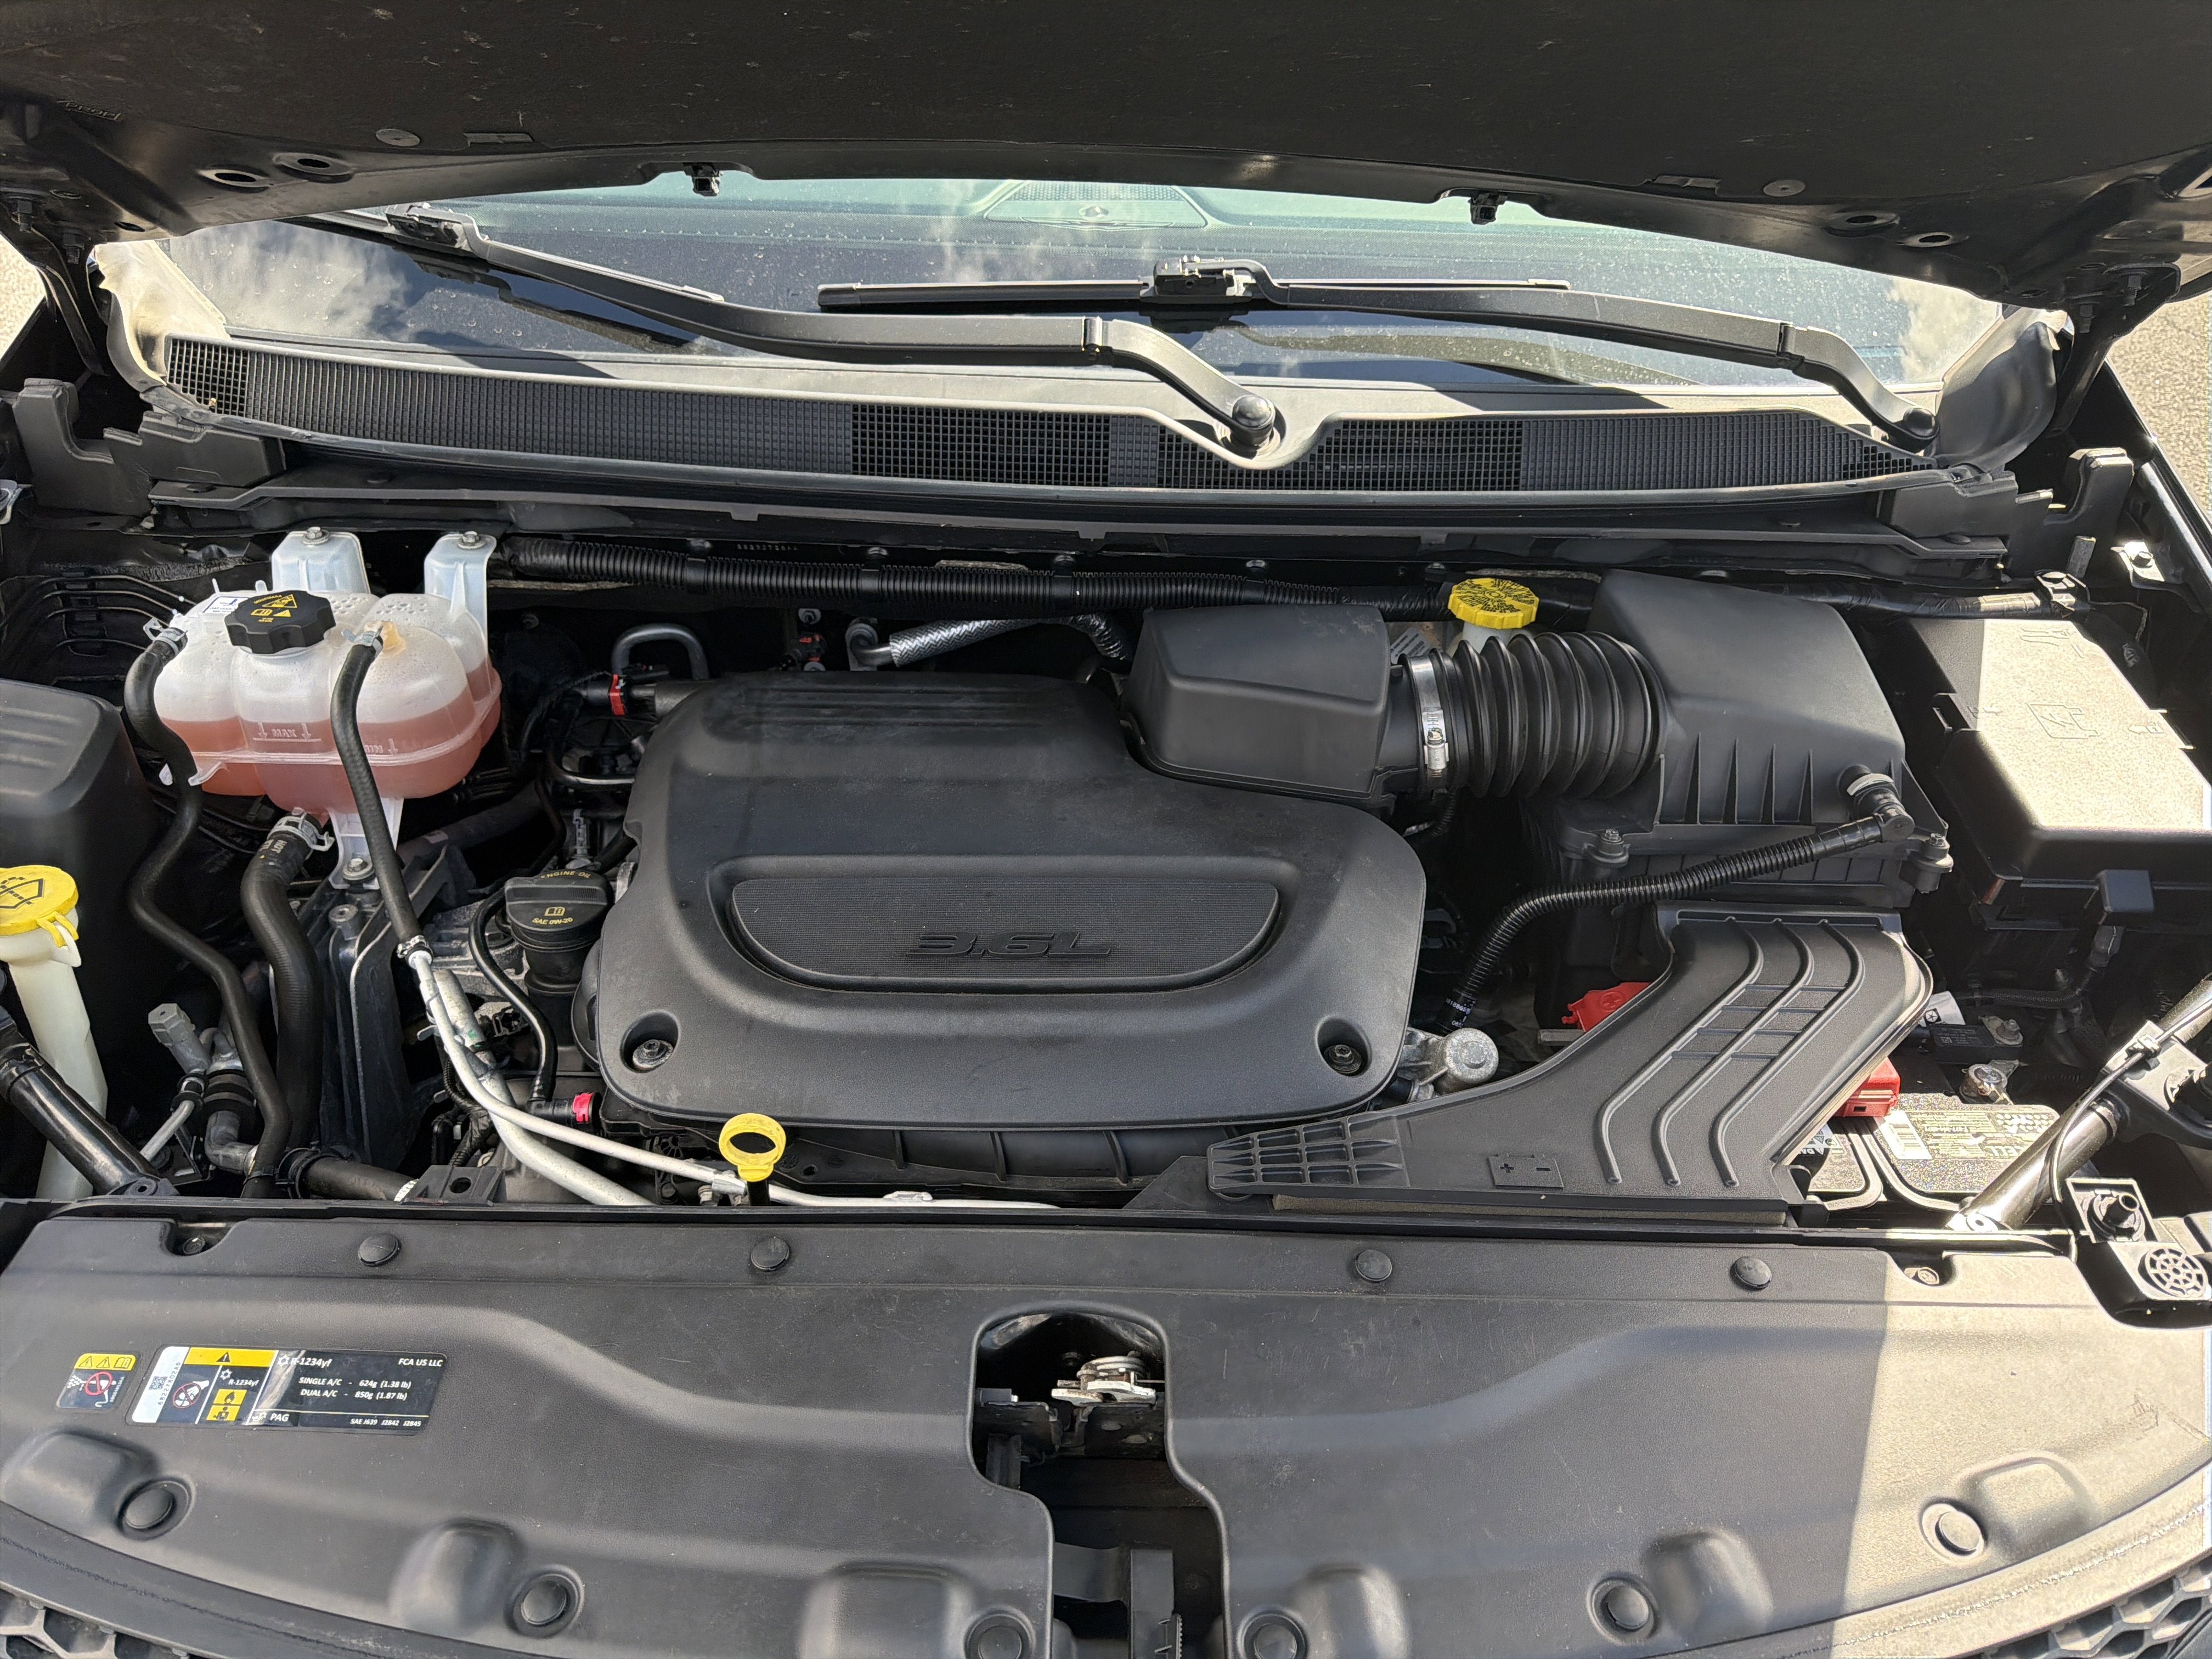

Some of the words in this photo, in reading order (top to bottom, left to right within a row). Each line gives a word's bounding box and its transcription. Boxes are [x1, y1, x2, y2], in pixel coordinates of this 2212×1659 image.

[272, 729, 297, 738] MAX
[540, 871, 575, 879] ENGINE
[532, 917, 548, 926] SAE
[549, 917, 574, 926] 0W-20
[907, 931, 1111, 958] 3.6L
[291, 1357, 332, 1368] R-1234yf
[398, 1358, 414, 1366] FCA
[228, 1378, 260, 1388] R-1234yf
[298, 1376, 326, 1386] SINGLE
[326, 1378, 343, 1386] A/C
[359, 1379, 377, 1388] 624g
[380, 1380, 399, 1388] (1.38
[400, 1380, 411, 1389] lb)
[300, 1388, 321, 1397] DUAL
[321, 1389, 338, 1398] A/C
[354, 1391, 373, 1400] 850g
[376, 1392, 396, 1400] (1.87
[396, 1392, 408, 1401] lb)
[269, 1413, 290, 1423] PAG
